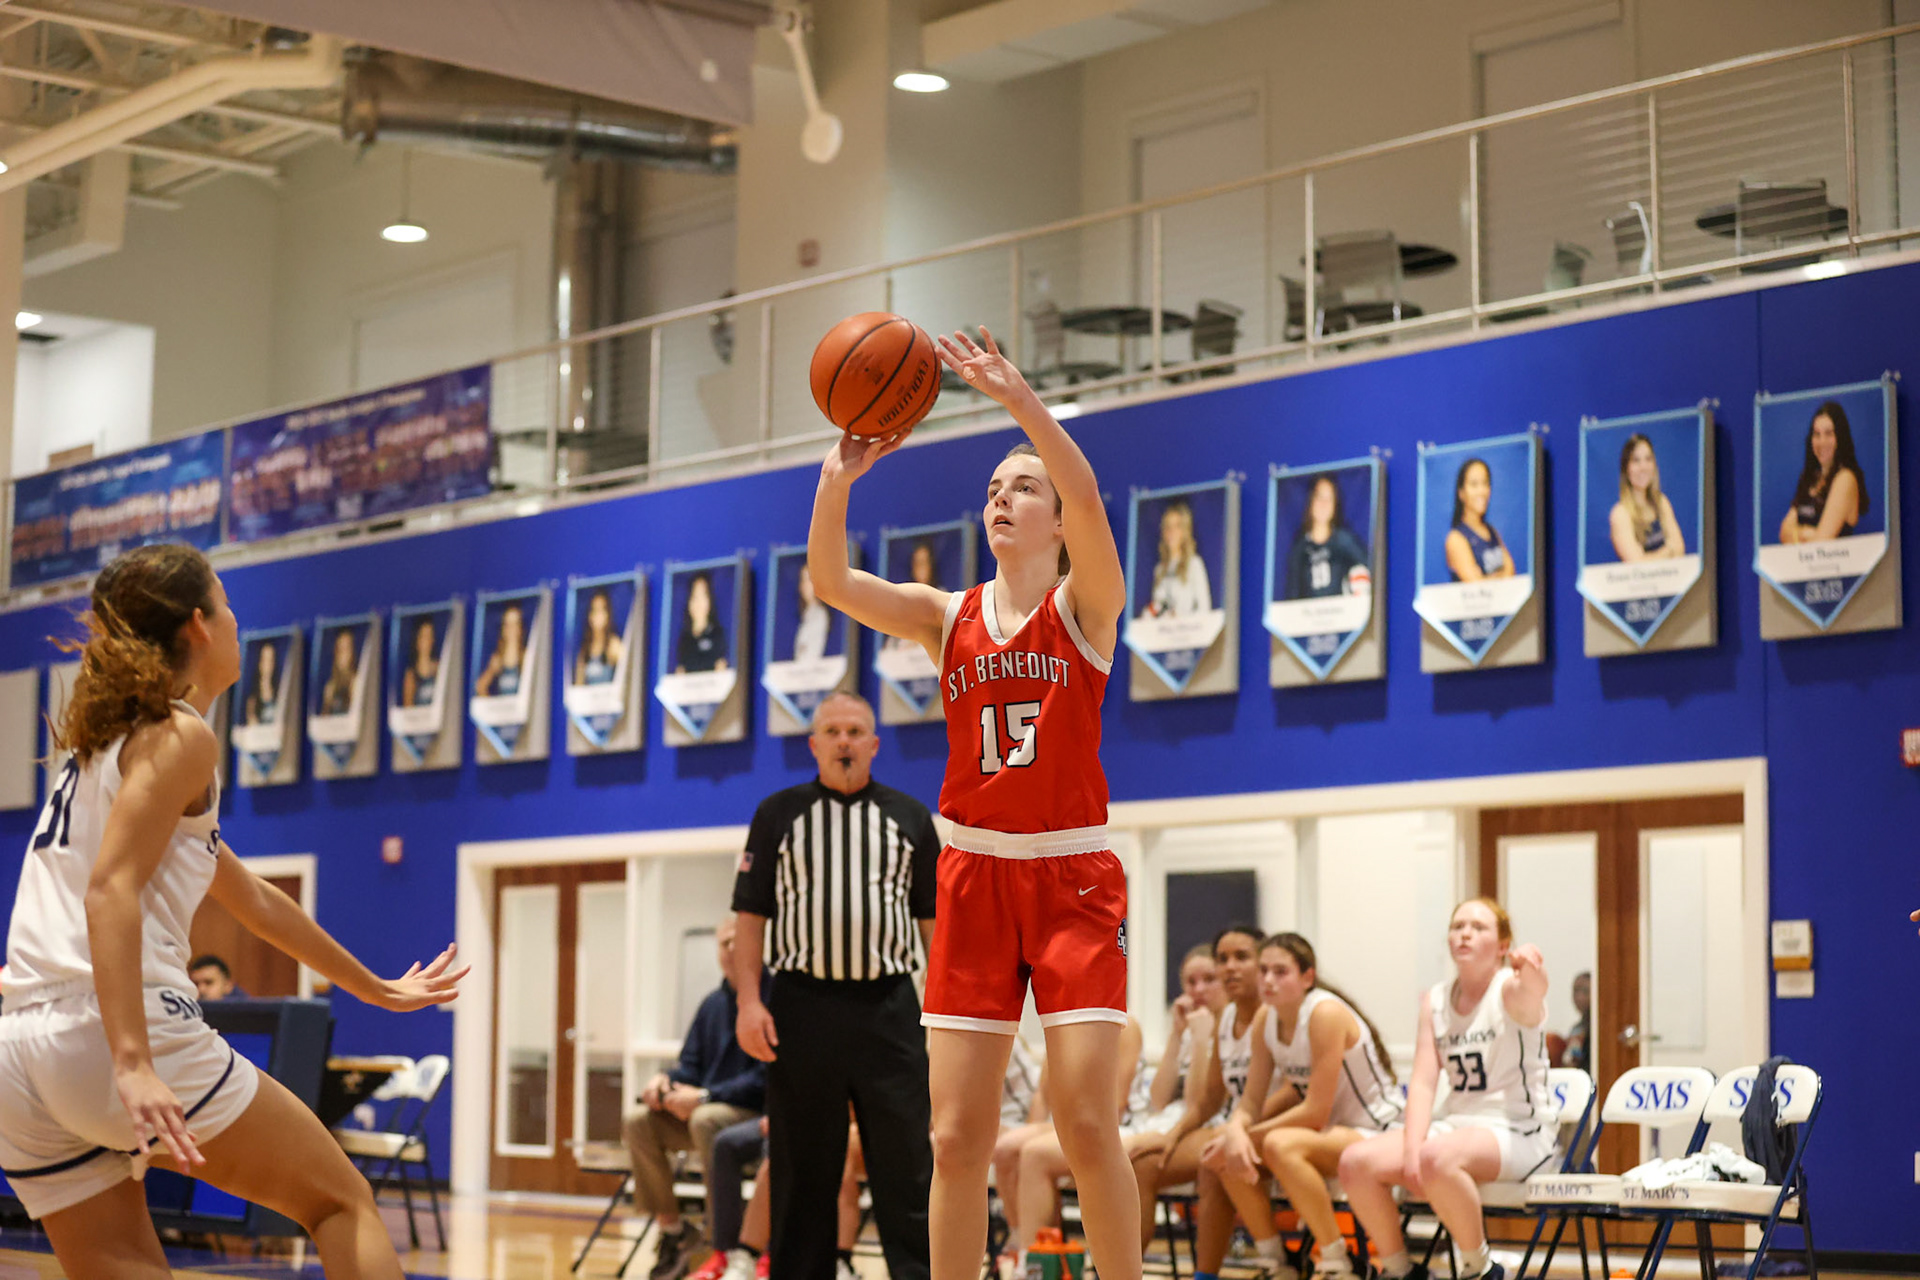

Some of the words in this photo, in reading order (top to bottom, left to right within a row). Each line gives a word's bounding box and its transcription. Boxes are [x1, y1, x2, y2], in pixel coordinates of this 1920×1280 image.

[948, 664, 976, 703] ST.
[974, 651, 1071, 688] BENEDICT
[979, 700, 1042, 776] 15
[1447, 1052, 1488, 1092] 33
[1625, 1080, 1692, 1111] SMS
[1729, 1077, 1795, 1109] SS
